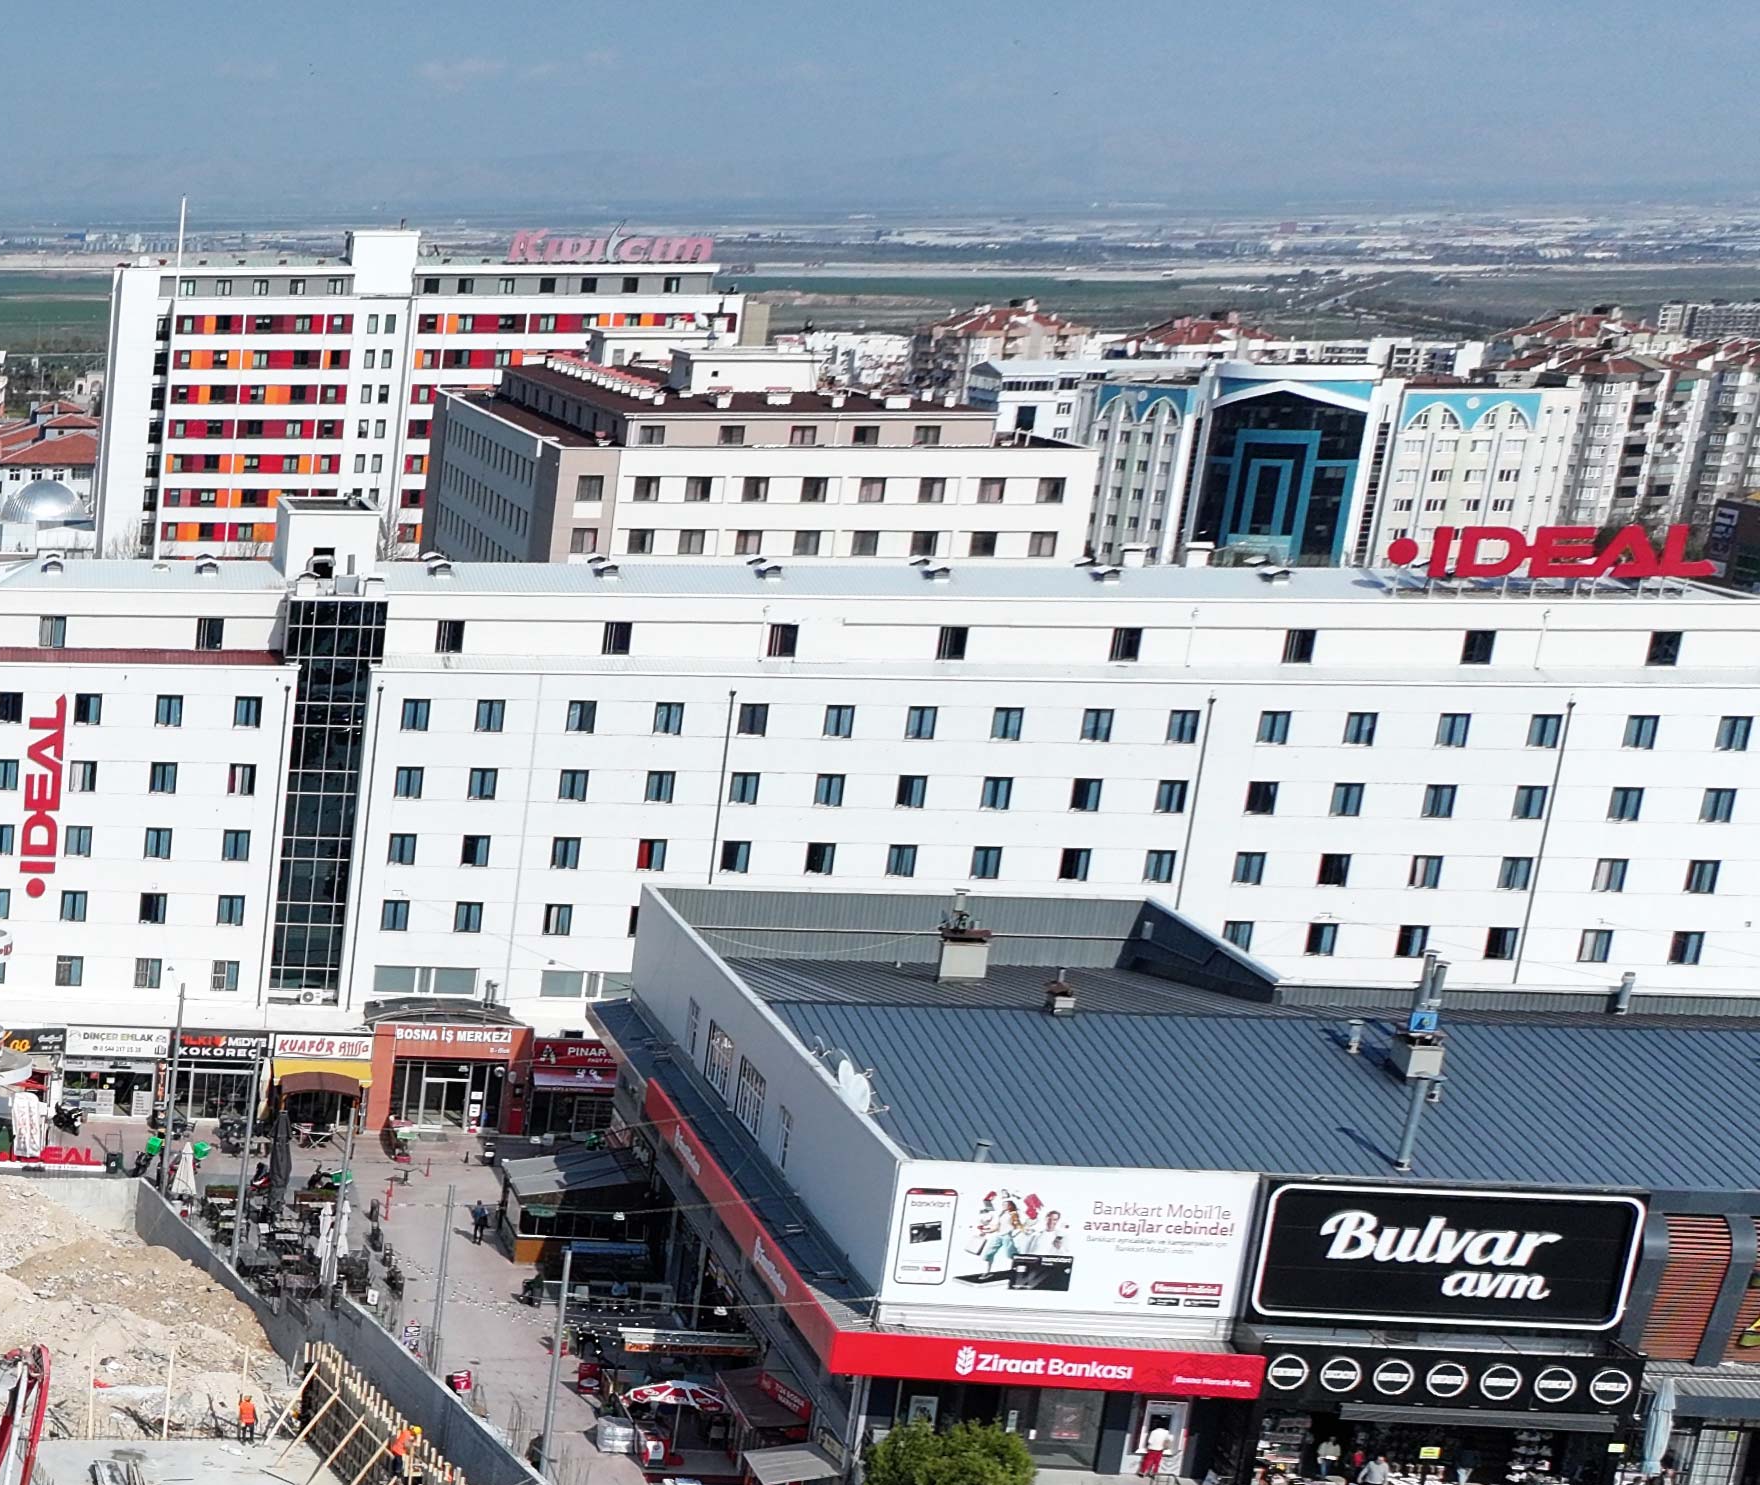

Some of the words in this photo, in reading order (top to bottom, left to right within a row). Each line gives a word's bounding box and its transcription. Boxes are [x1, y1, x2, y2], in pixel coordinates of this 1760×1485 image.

[396, 1027, 437, 1041] BOSNA
[441, 1026, 453, 1043] İŞ
[456, 1027, 513, 1043] MERKEZİ
[278, 1038, 335, 1053] KUAFÖR
[567, 1046, 606, 1057] PINAR
[1092, 1200, 1163, 1217] Bankkart
[1083, 1219, 1163, 1236] avantajlar
[1165, 1221, 1235, 1237] cebinde!
[1319, 1209, 1563, 1267] Bulvar
[1441, 1271, 1551, 1301] avm
[977, 1353, 1044, 1375] Ziraat
[1047, 1357, 1134, 1380] Bankası
